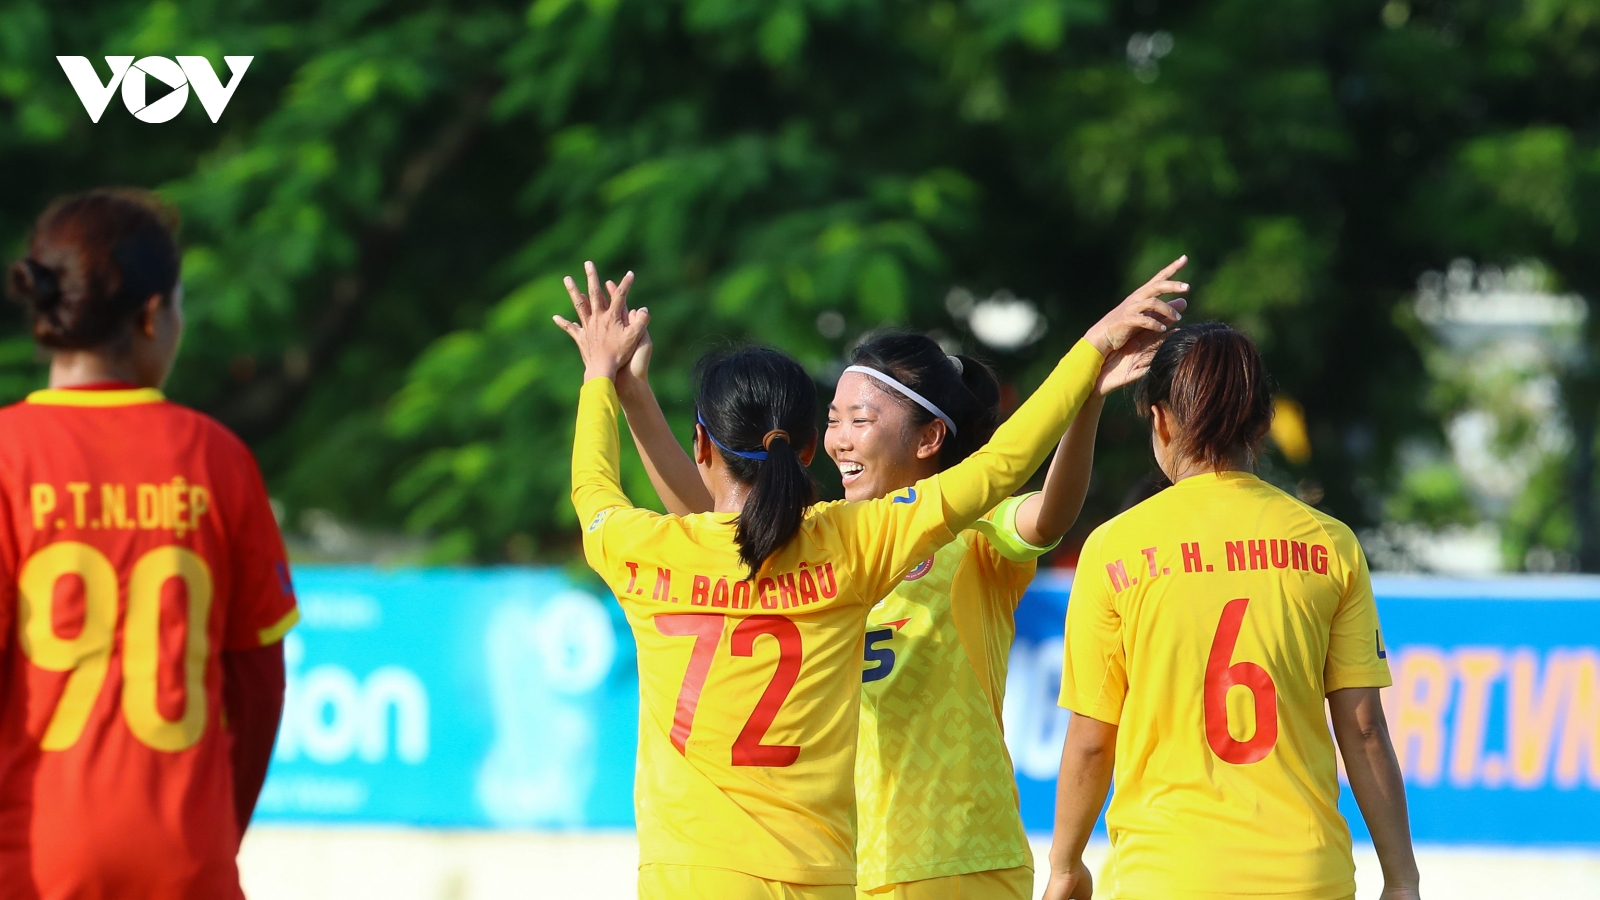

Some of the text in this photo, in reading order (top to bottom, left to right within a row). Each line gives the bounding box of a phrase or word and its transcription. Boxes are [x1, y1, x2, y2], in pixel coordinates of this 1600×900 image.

[652, 567, 678, 602] N.
[758, 562, 838, 609] CHÂU
[1105, 539, 1328, 594] N. T. H. NHUNG
[18, 541, 213, 752] 90
[654, 613, 802, 767] 72
[1203, 598, 1278, 764] 6
